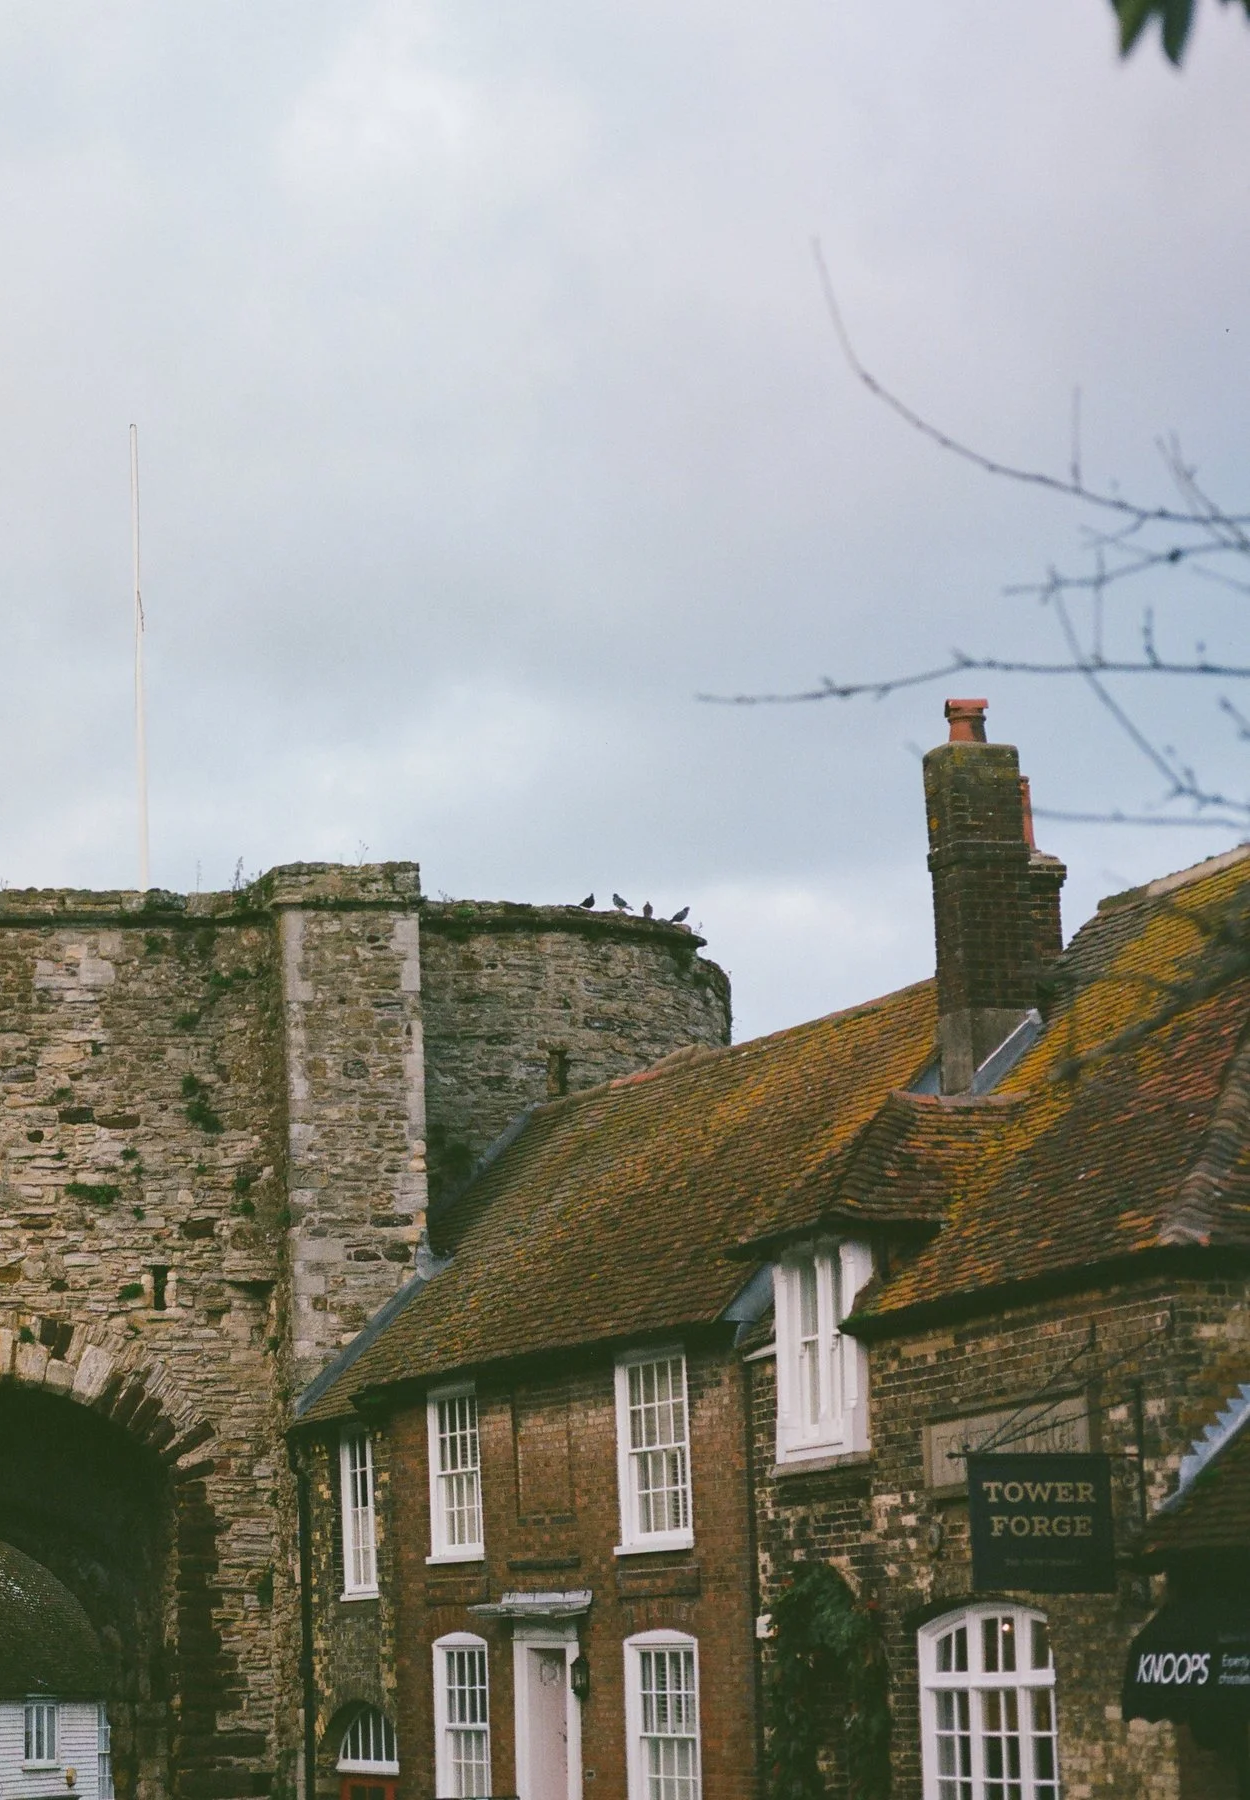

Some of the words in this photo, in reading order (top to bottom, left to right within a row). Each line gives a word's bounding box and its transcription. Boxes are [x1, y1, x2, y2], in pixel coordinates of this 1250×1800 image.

[982, 1482, 1096, 1503] TOWER
[990, 1516, 1092, 1537] FORGE
[1136, 1653, 1211, 1685] KNOOPS
